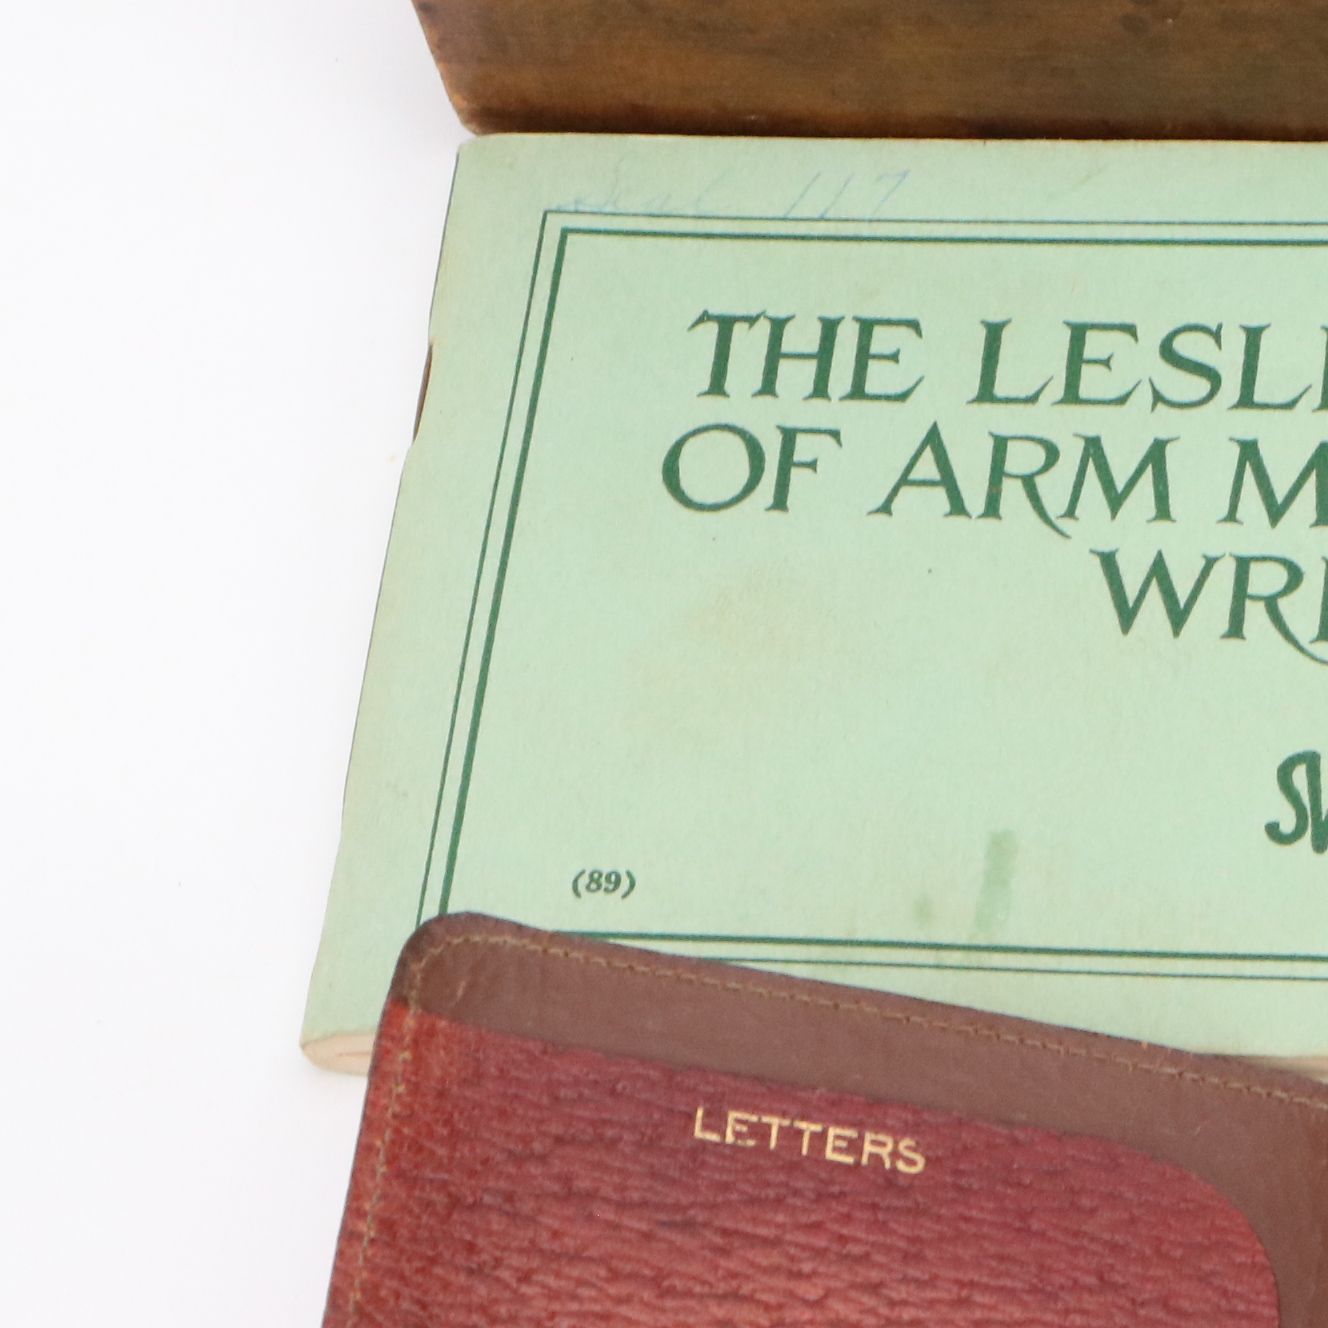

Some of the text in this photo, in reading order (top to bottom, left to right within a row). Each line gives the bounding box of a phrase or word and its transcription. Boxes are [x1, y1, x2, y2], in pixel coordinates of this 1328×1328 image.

[688, 310, 925, 403] THE
[661, 422, 843, 513] OF
[867, 420, 1180, 539] ARM
[571, 869, 636, 899] (89)
[694, 1107, 927, 1174] LETTERS
